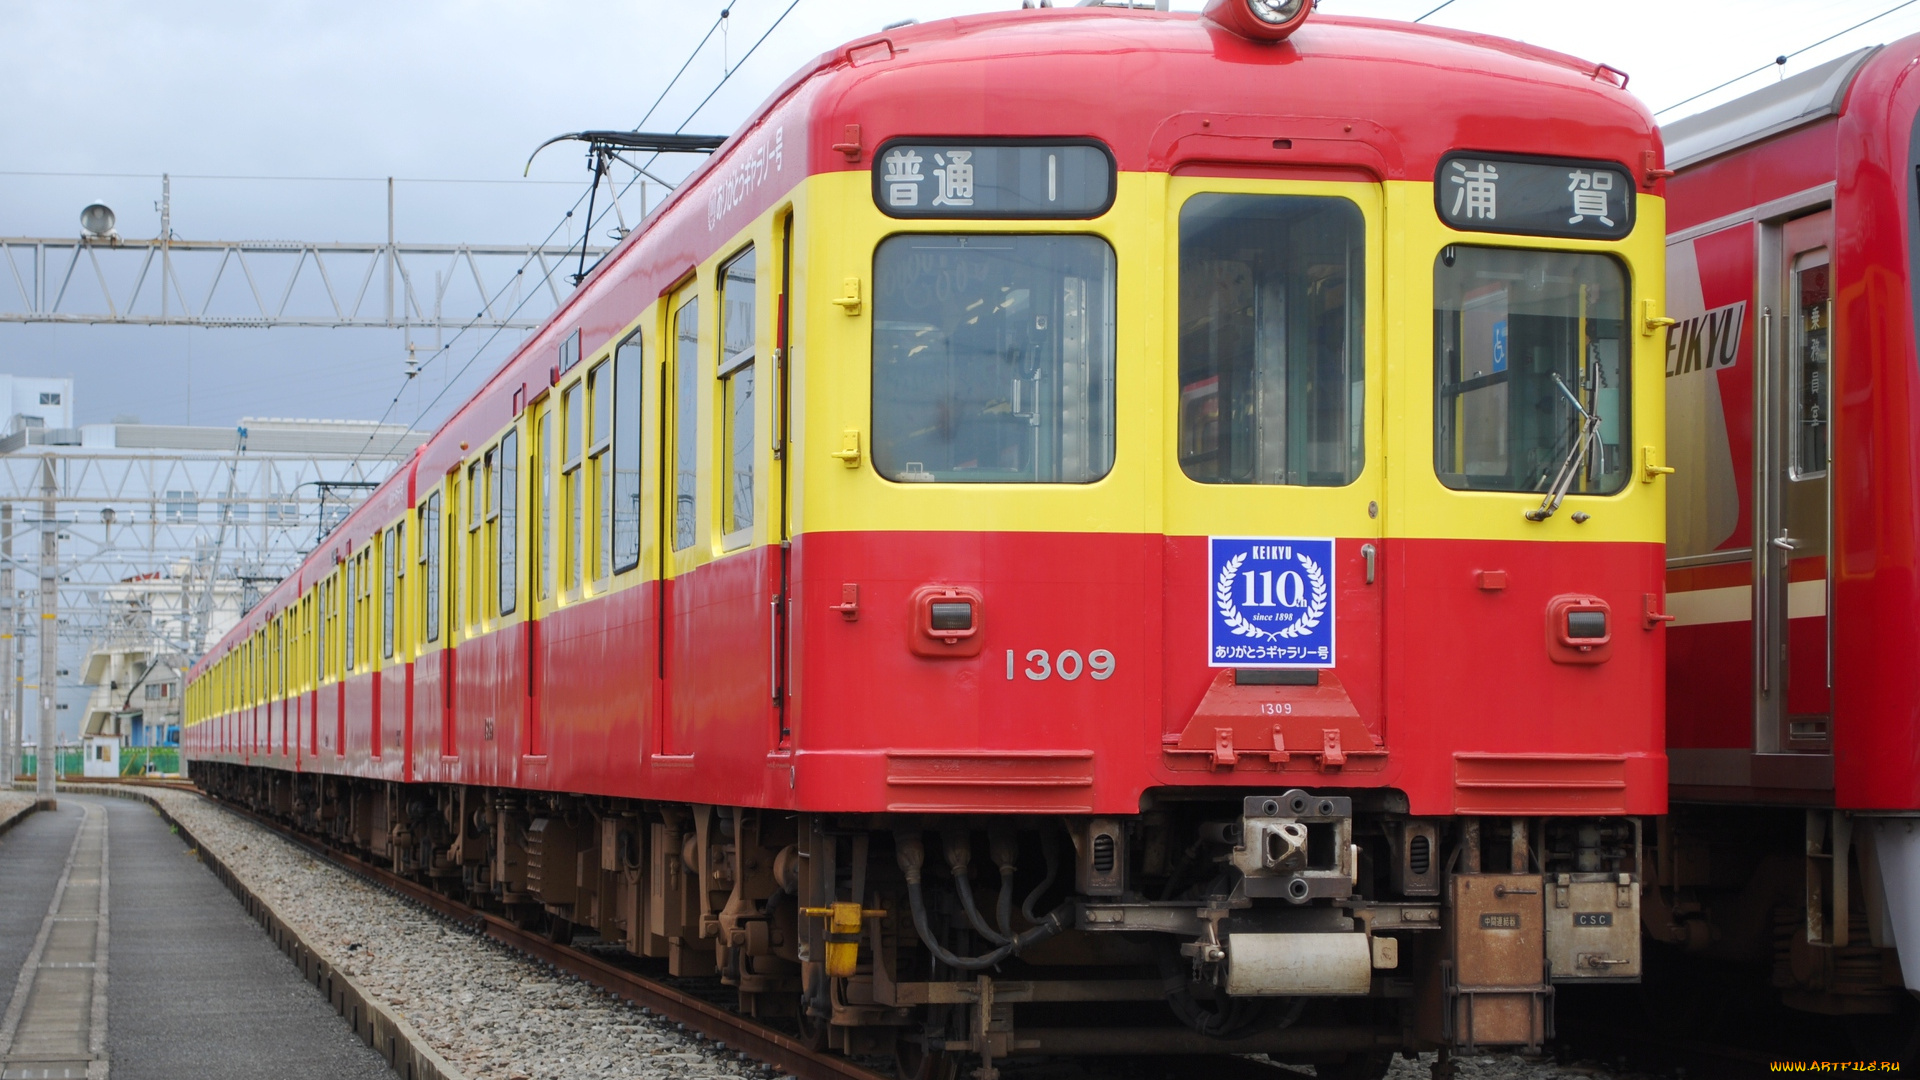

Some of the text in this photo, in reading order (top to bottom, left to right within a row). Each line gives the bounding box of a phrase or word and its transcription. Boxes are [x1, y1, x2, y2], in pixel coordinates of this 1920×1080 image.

[884, 150, 974, 206] 普通
[1450, 161, 1615, 227] 浦賀
[1666, 304, 1744, 378] EIKYU
[1252, 545, 1292, 560] KEIKYU
[1252, 612, 1294, 621] since 1898
[1215, 645, 1329, 660] ありがとうギャラリー号
[1006, 649, 1116, 681] 1309
[1261, 703, 1292, 715] 1309
[1579, 915, 1606, 925] CSC
